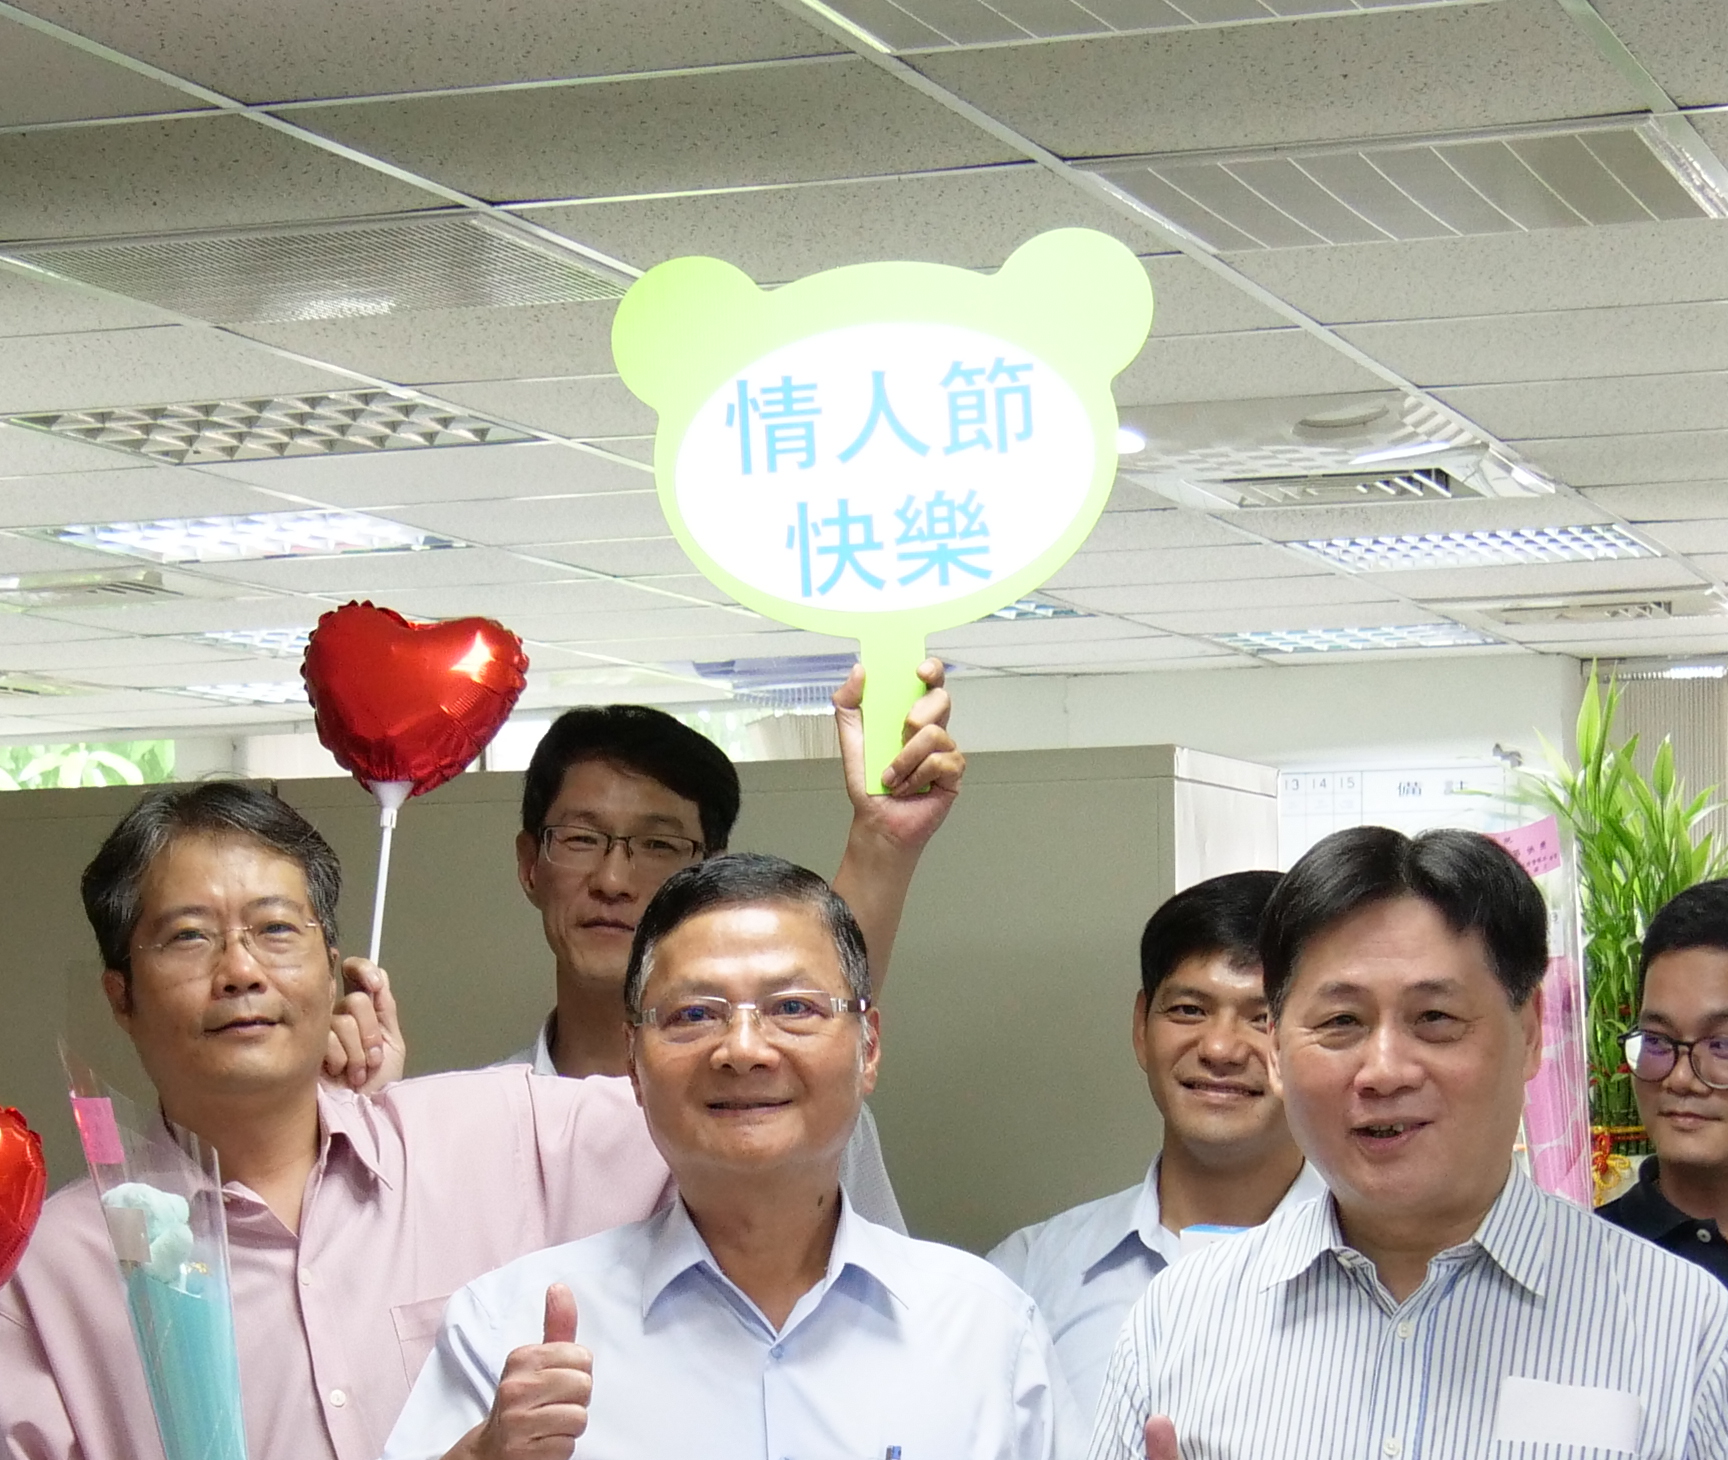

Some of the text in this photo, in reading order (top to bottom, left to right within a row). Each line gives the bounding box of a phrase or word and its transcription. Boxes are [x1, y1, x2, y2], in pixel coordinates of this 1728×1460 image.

[724, 356, 1036, 476] 情人節
[785, 489, 994, 598] 快樂
[1312, 778, 1327, 790] 14
[1340, 777, 1355, 789] 15
